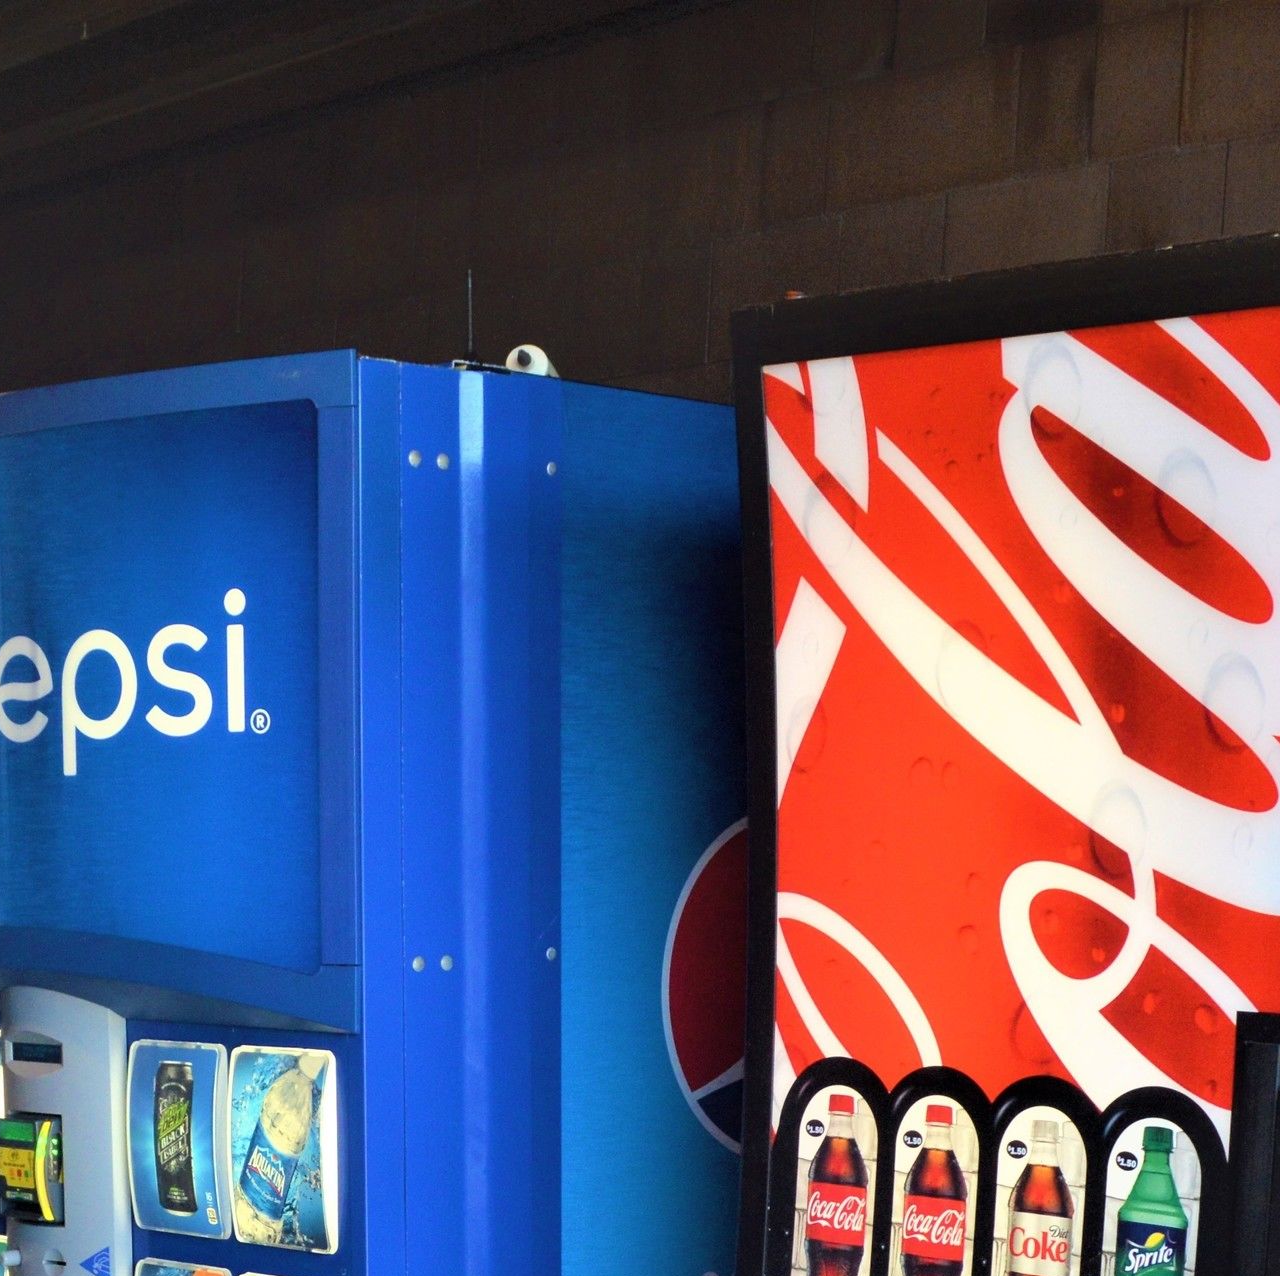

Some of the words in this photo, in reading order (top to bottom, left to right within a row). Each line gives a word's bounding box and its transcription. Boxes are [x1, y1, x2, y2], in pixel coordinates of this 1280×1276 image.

[807, 1125, 824, 1134] $1.50
[904, 1135, 922, 1145] $1.50
[1007, 1145, 1027, 1156] $1.50
[1117, 1157, 1137, 1168] $1.50
[808, 1191, 866, 1232] Coca-Cola
[903, 1205, 965, 1246] Coca-Cola
[1049, 1226, 1069, 1239] Diet
[1009, 1227, 1069, 1263] Coke
[1125, 1243, 1173, 1274] Sprite
